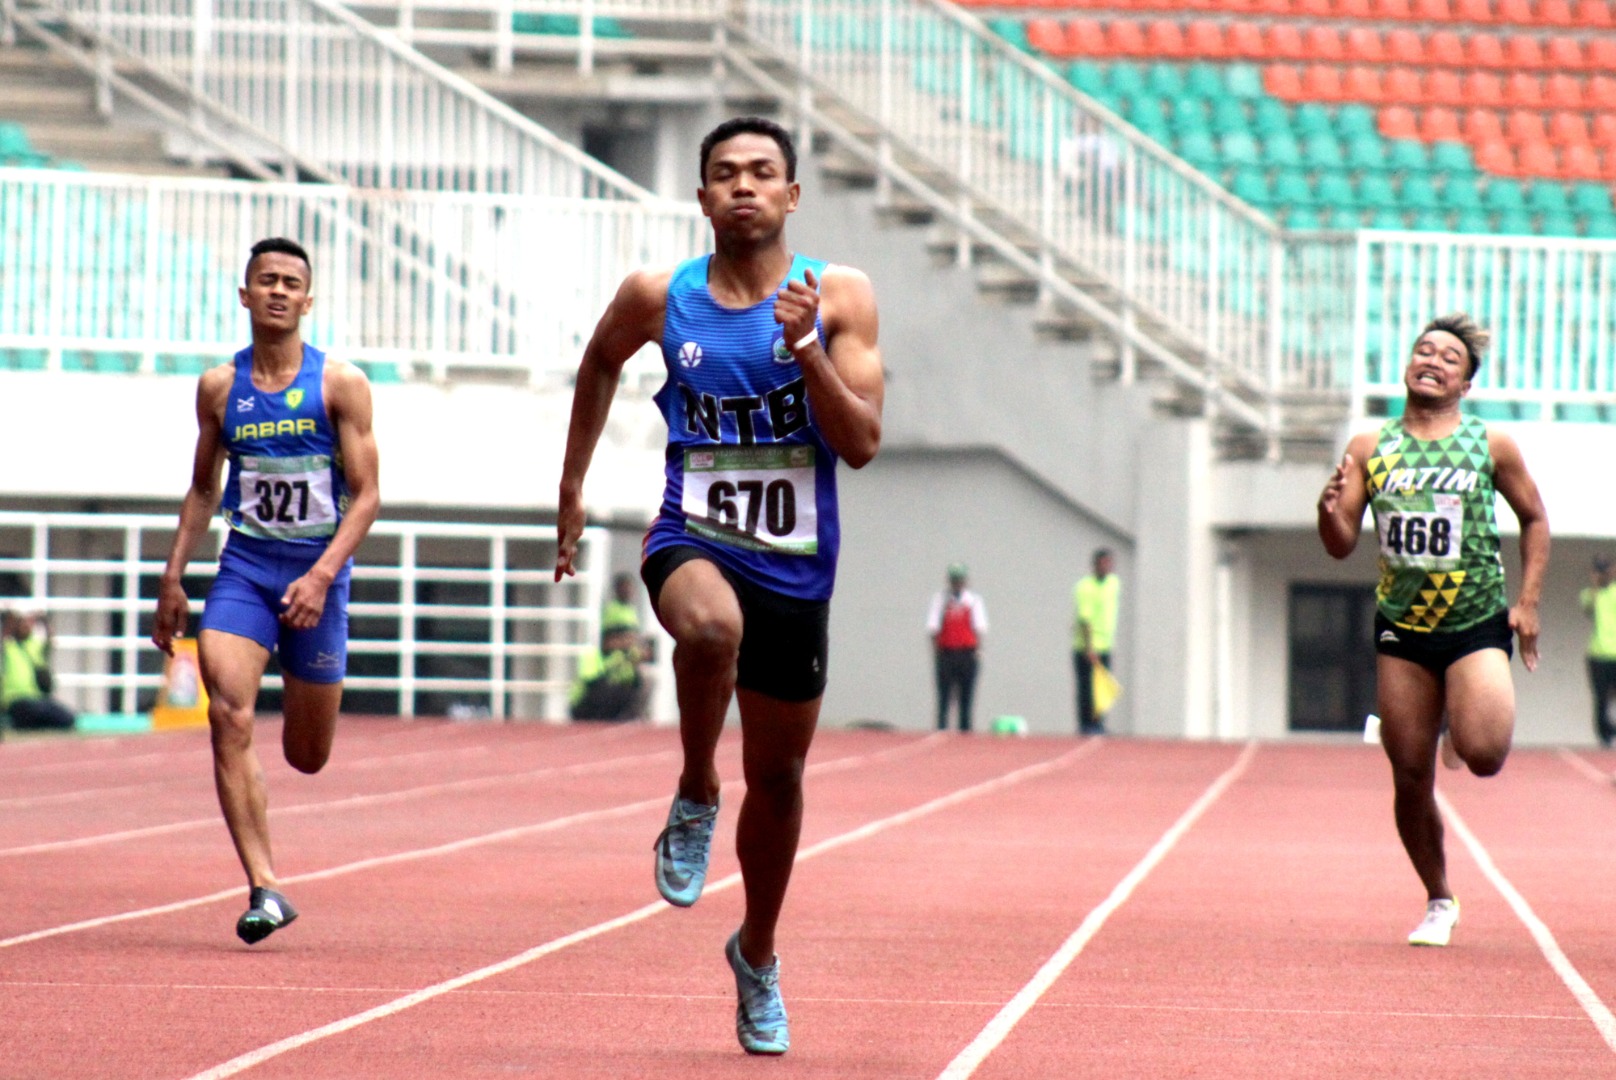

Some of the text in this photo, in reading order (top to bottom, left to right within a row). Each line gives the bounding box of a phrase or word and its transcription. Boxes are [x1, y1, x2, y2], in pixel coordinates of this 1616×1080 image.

[231, 418, 315, 441] JABAR
[677, 376, 811, 445] NTB
[254, 480, 309, 523] 327
[708, 478, 796, 537] 670
[1388, 517, 1451, 556] 468
